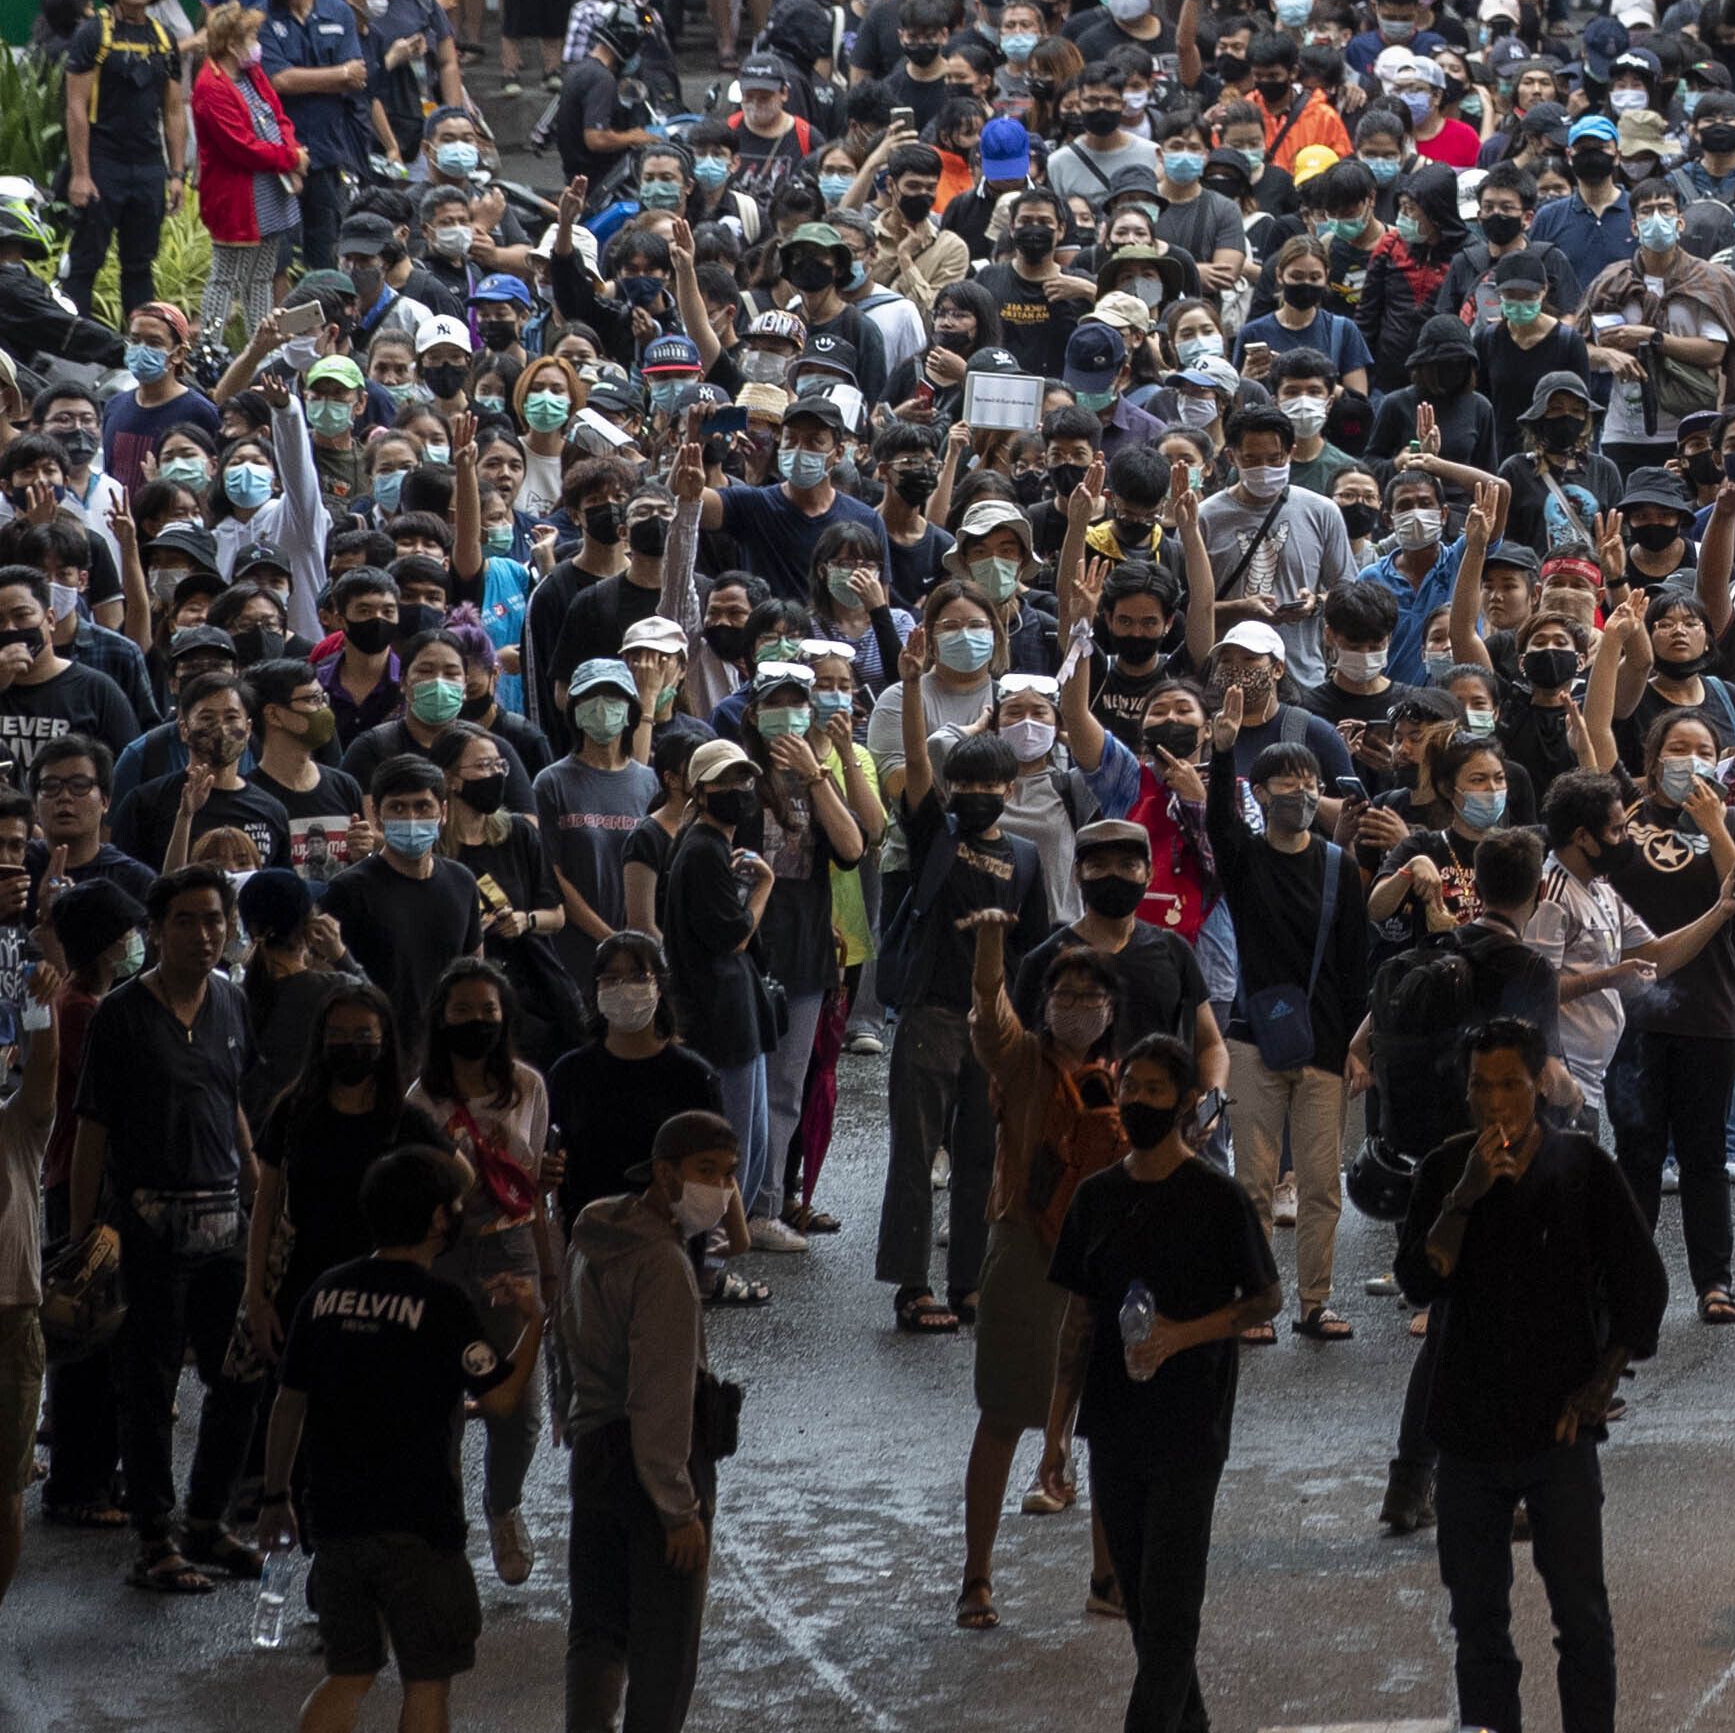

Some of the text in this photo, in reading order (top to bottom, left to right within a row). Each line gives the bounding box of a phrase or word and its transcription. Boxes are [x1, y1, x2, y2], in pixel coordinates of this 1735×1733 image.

[698, 385, 716, 402] NY
[0, 715, 72, 738] EVER
[291, 839, 347, 861] upme
[310, 1289, 425, 1331] MELVIN
